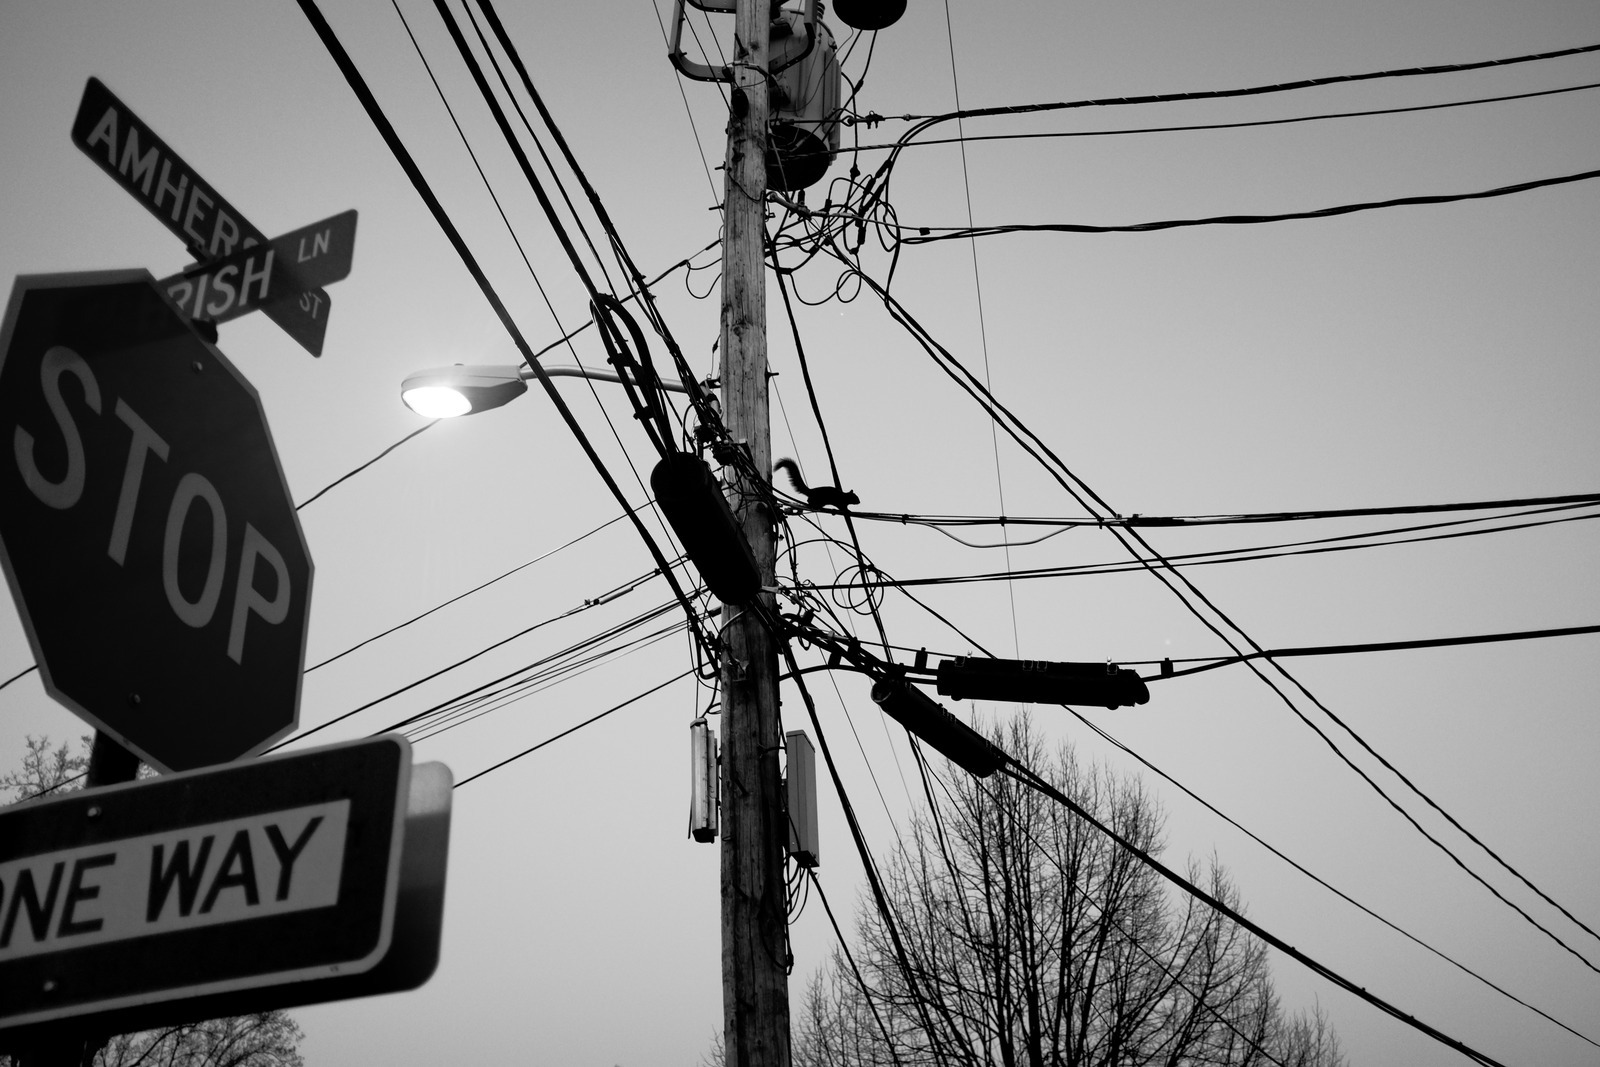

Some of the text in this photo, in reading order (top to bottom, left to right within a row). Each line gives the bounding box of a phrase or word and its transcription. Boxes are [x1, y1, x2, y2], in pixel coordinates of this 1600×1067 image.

[86, 106, 323, 319] AMHER ST
[297, 229, 331, 263] LN
[14, 345, 292, 666] STOP
[0, 816, 325, 949] NE WAY
